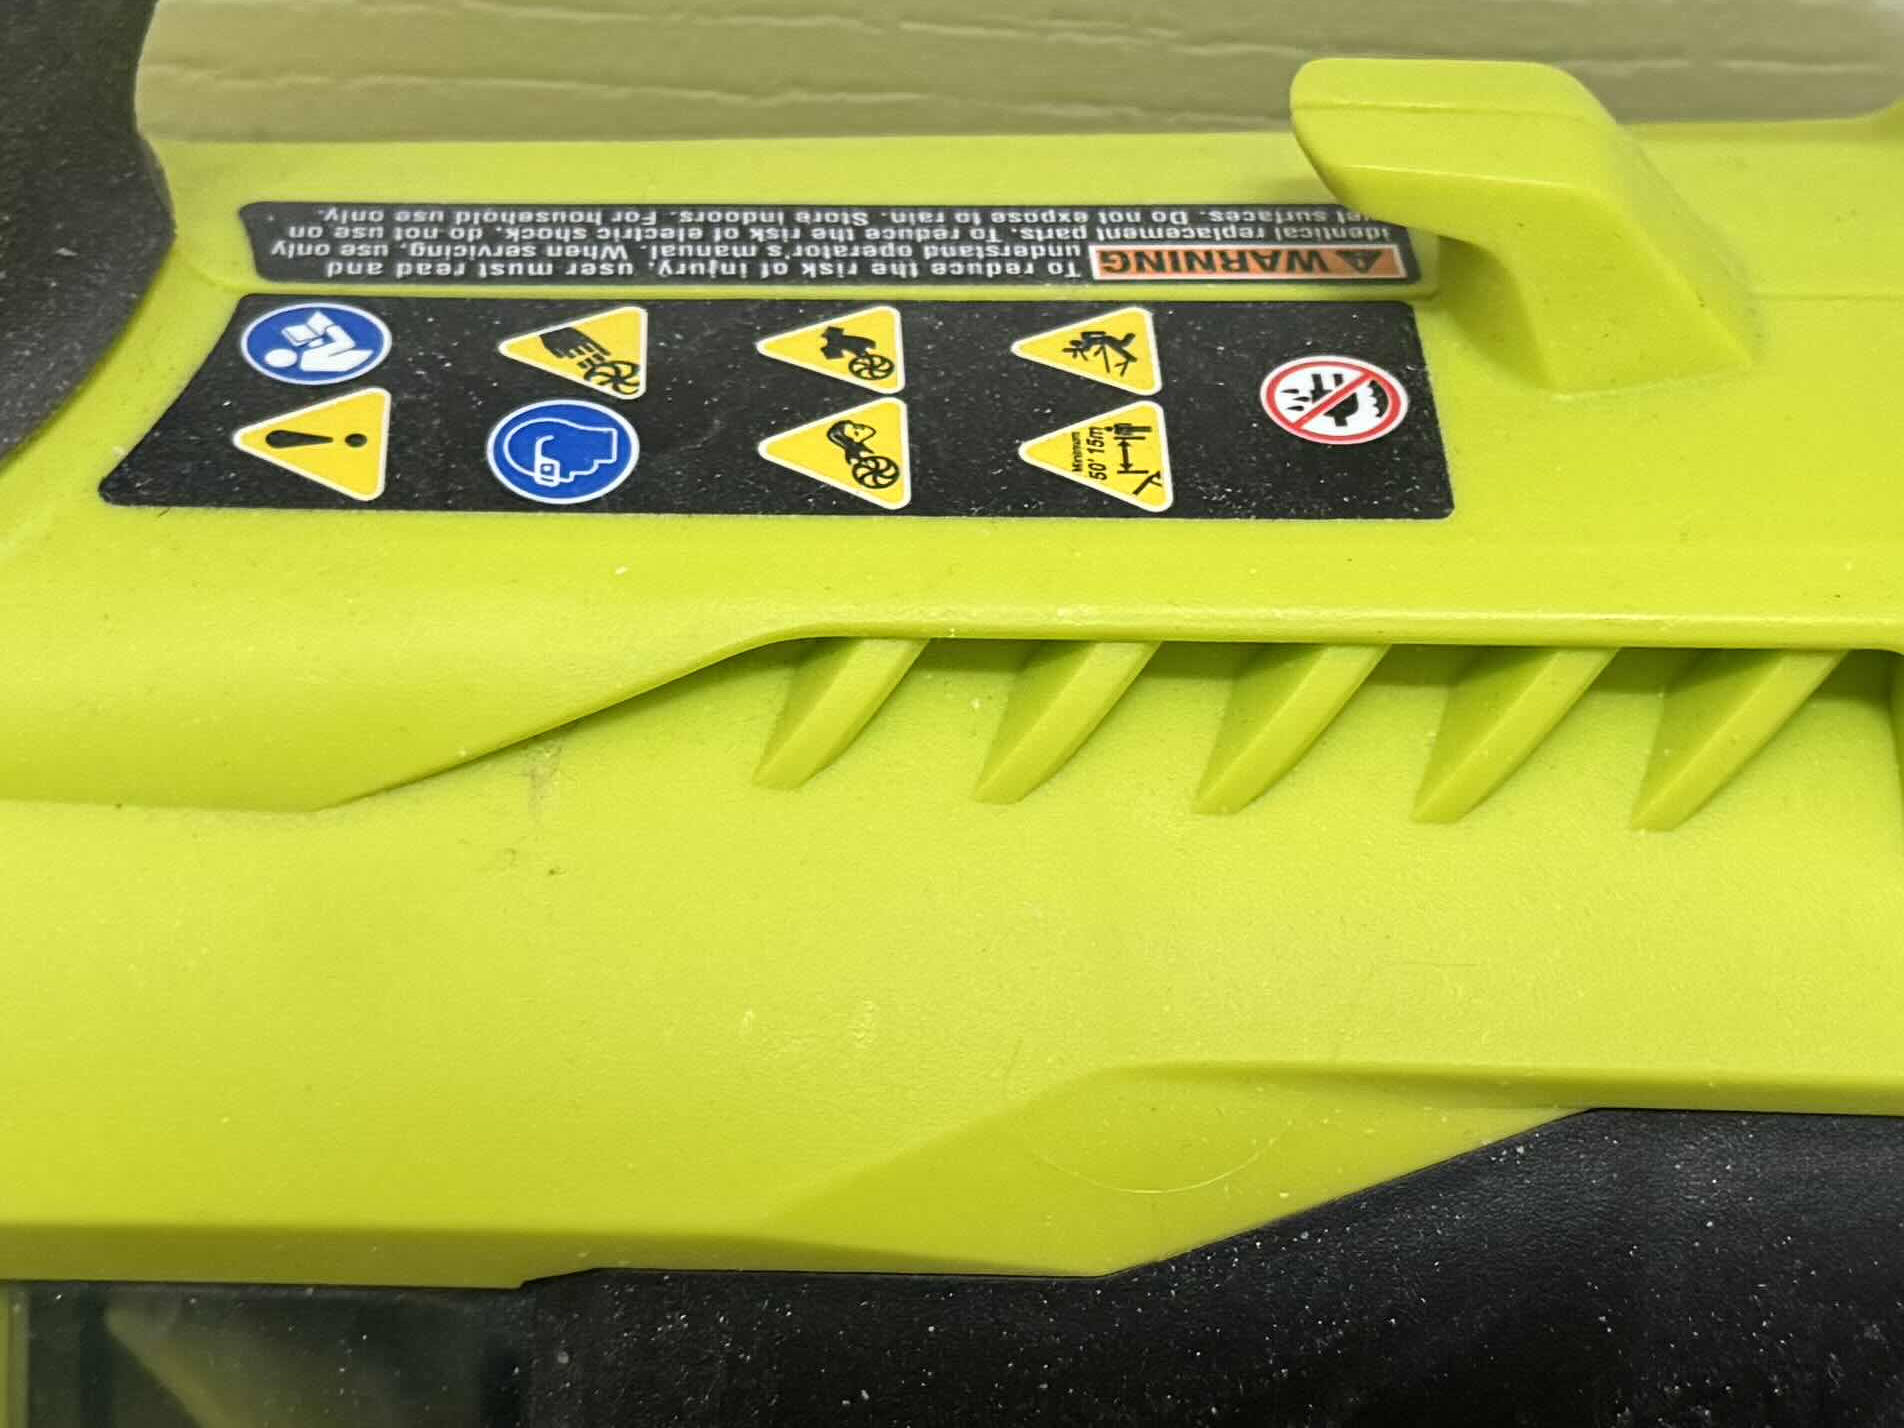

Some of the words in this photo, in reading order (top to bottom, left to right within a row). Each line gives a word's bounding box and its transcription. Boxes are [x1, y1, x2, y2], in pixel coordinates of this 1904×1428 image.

[395, 211, 444, 223] use
[455, 211, 601, 225] household
[611, 211, 657, 225] For
[795, 211, 869, 226] Store
[955, 212, 982, 225] to
[991, 210, 1088, 223] expose
[1097, 211, 1141, 224] not
[1151, 211, 1188, 225] Do
[288, 226, 323, 239] on
[334, 227, 384, 239] use
[393, 228, 438, 241] not
[449, 228, 483, 242] do
[596, 228, 703, 242] electric
[713, 228, 739, 242] of
[749, 228, 800, 242] risk
[812, 228, 854, 242] the
[865, 228, 960, 242] reduce
[970, 228, 1002, 242] To
[1097, 225, 1265, 242] replacement
[1275, 227, 1390, 241] identical
[271, 241, 330, 258] only
[341, 244, 389, 257] use
[547, 245, 627, 260] When
[640, 245, 756, 260] manual.
[767, 243, 912, 260] operator's
[924, 245, 1080, 260] understand
[566, 262, 634, 276] user
[1100, 250, 1329, 274] WARNING
[327, 262, 383, 278] and
[396, 262, 465, 278] read
[478, 262, 553, 278] must
[760, 262, 788, 278] of
[801, 262, 858, 278] risk
[871, 262, 918, 278] the
[931, 262, 1034, 278] reduce
[1048, 262, 1080, 278] To
[1086, 427, 1105, 454] 15m
